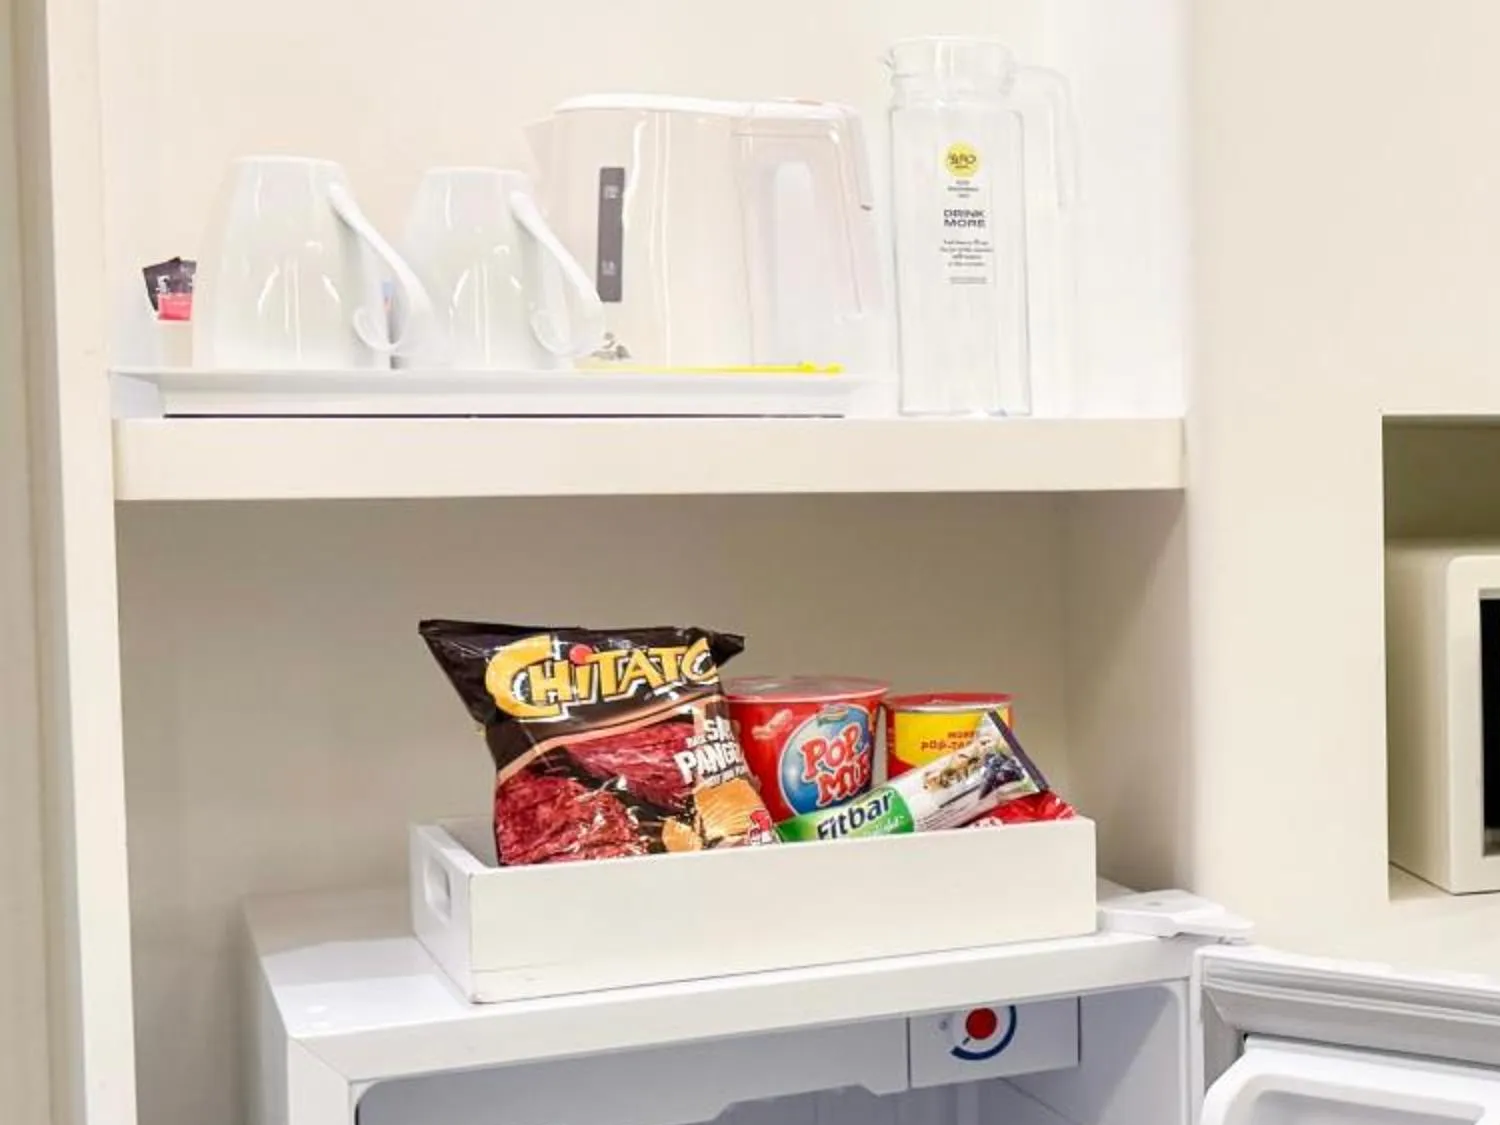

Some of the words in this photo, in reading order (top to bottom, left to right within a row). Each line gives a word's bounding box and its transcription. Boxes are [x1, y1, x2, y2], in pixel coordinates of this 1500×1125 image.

[943, 209, 985, 218] DRINK
[943, 218, 986, 228] MORE
[801, 723, 861, 782] POP
[817, 793, 891, 840] Fitbar
